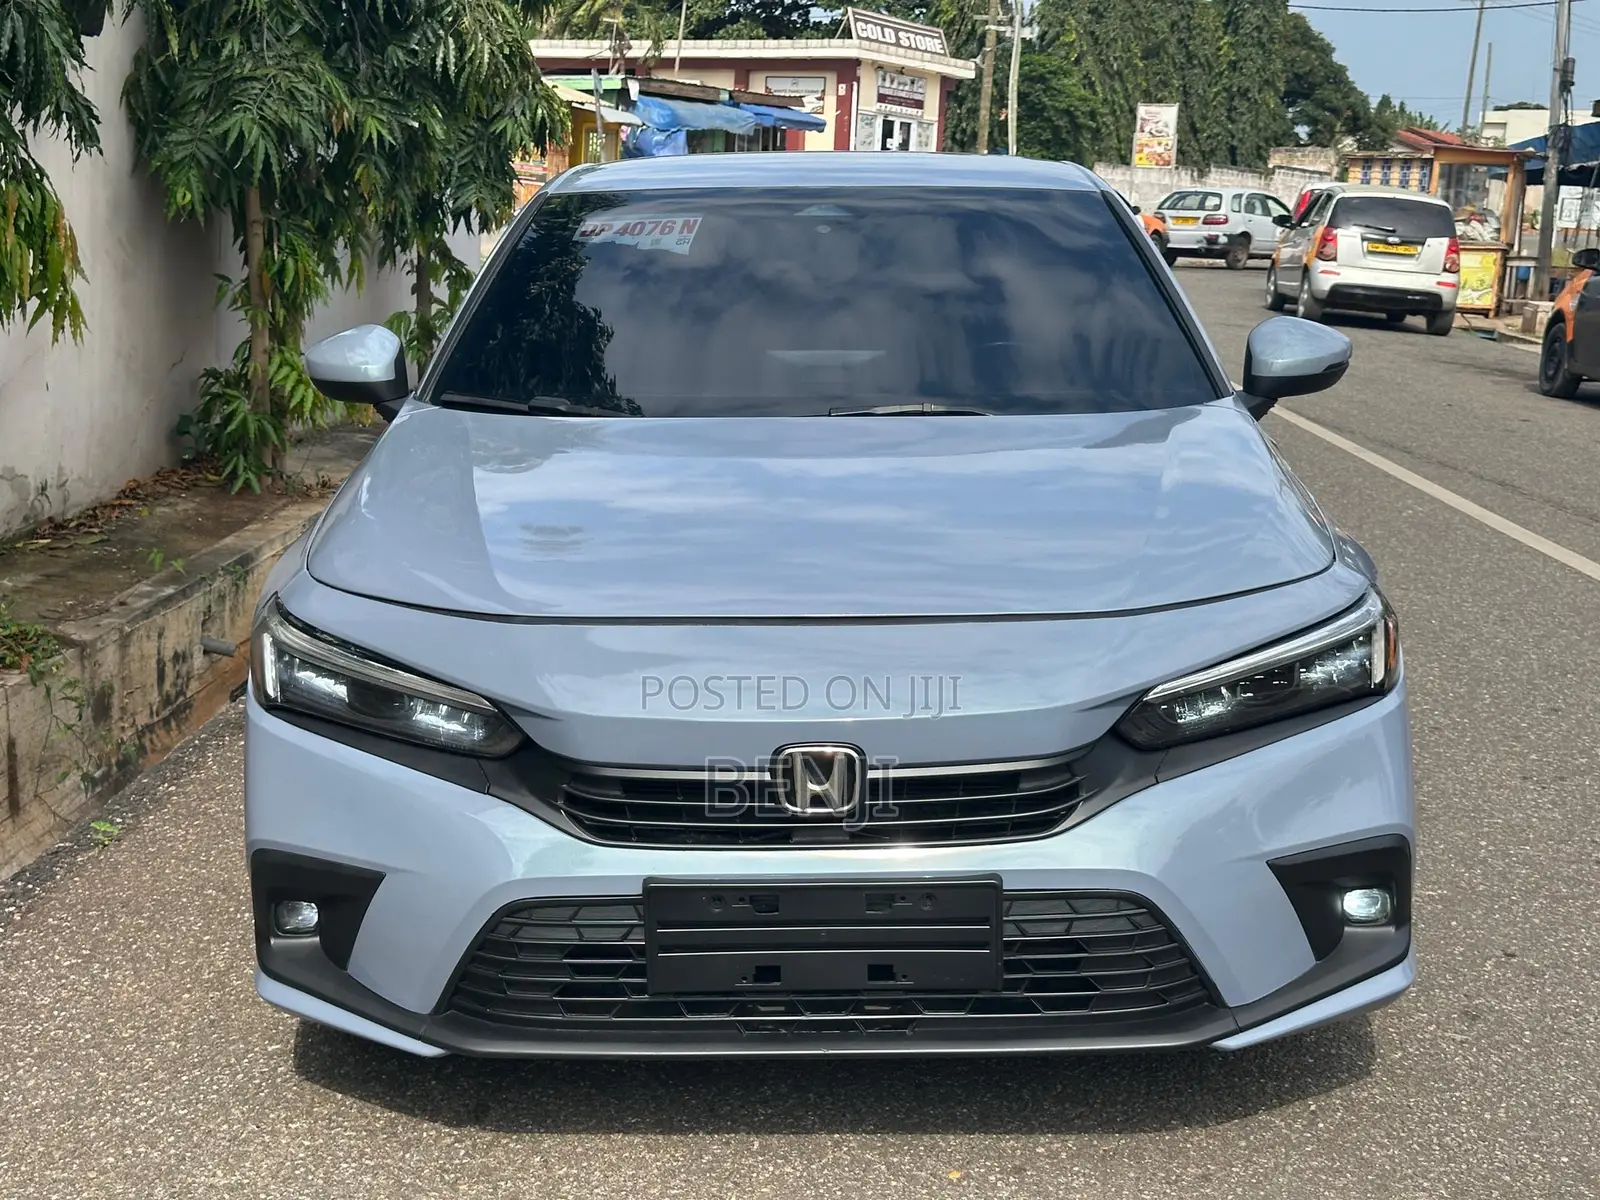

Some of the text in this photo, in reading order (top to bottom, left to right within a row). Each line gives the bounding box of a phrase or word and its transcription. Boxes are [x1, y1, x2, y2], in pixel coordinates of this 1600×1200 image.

[856, 21, 945, 54] COLD STORE
[613, 220, 676, 237] 4076
[678, 219, 699, 235] N
